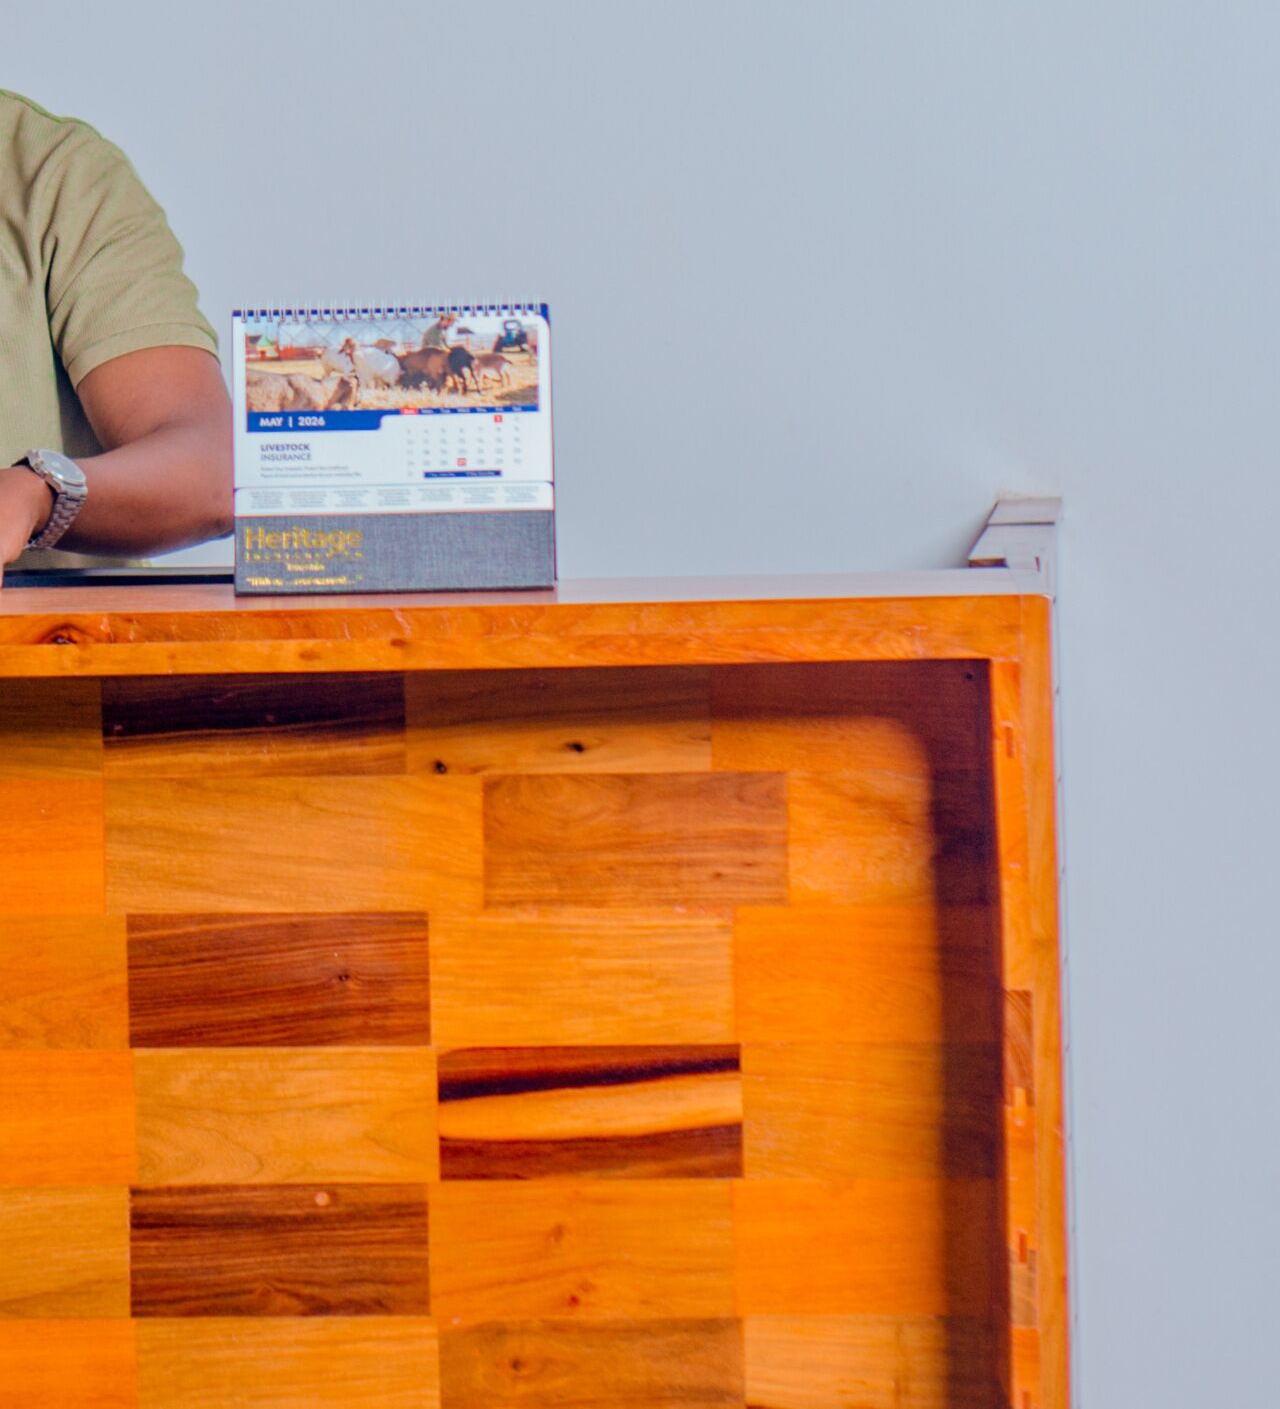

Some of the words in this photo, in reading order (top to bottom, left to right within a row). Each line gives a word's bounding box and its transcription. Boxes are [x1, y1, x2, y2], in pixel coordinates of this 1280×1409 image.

[259, 417, 283, 427] MAY
[298, 416, 326, 427] 2026
[260, 443, 310, 452] LIVESTOCK
[260, 453, 312, 462] INSURANCE
[244, 525, 363, 553] Heritage
